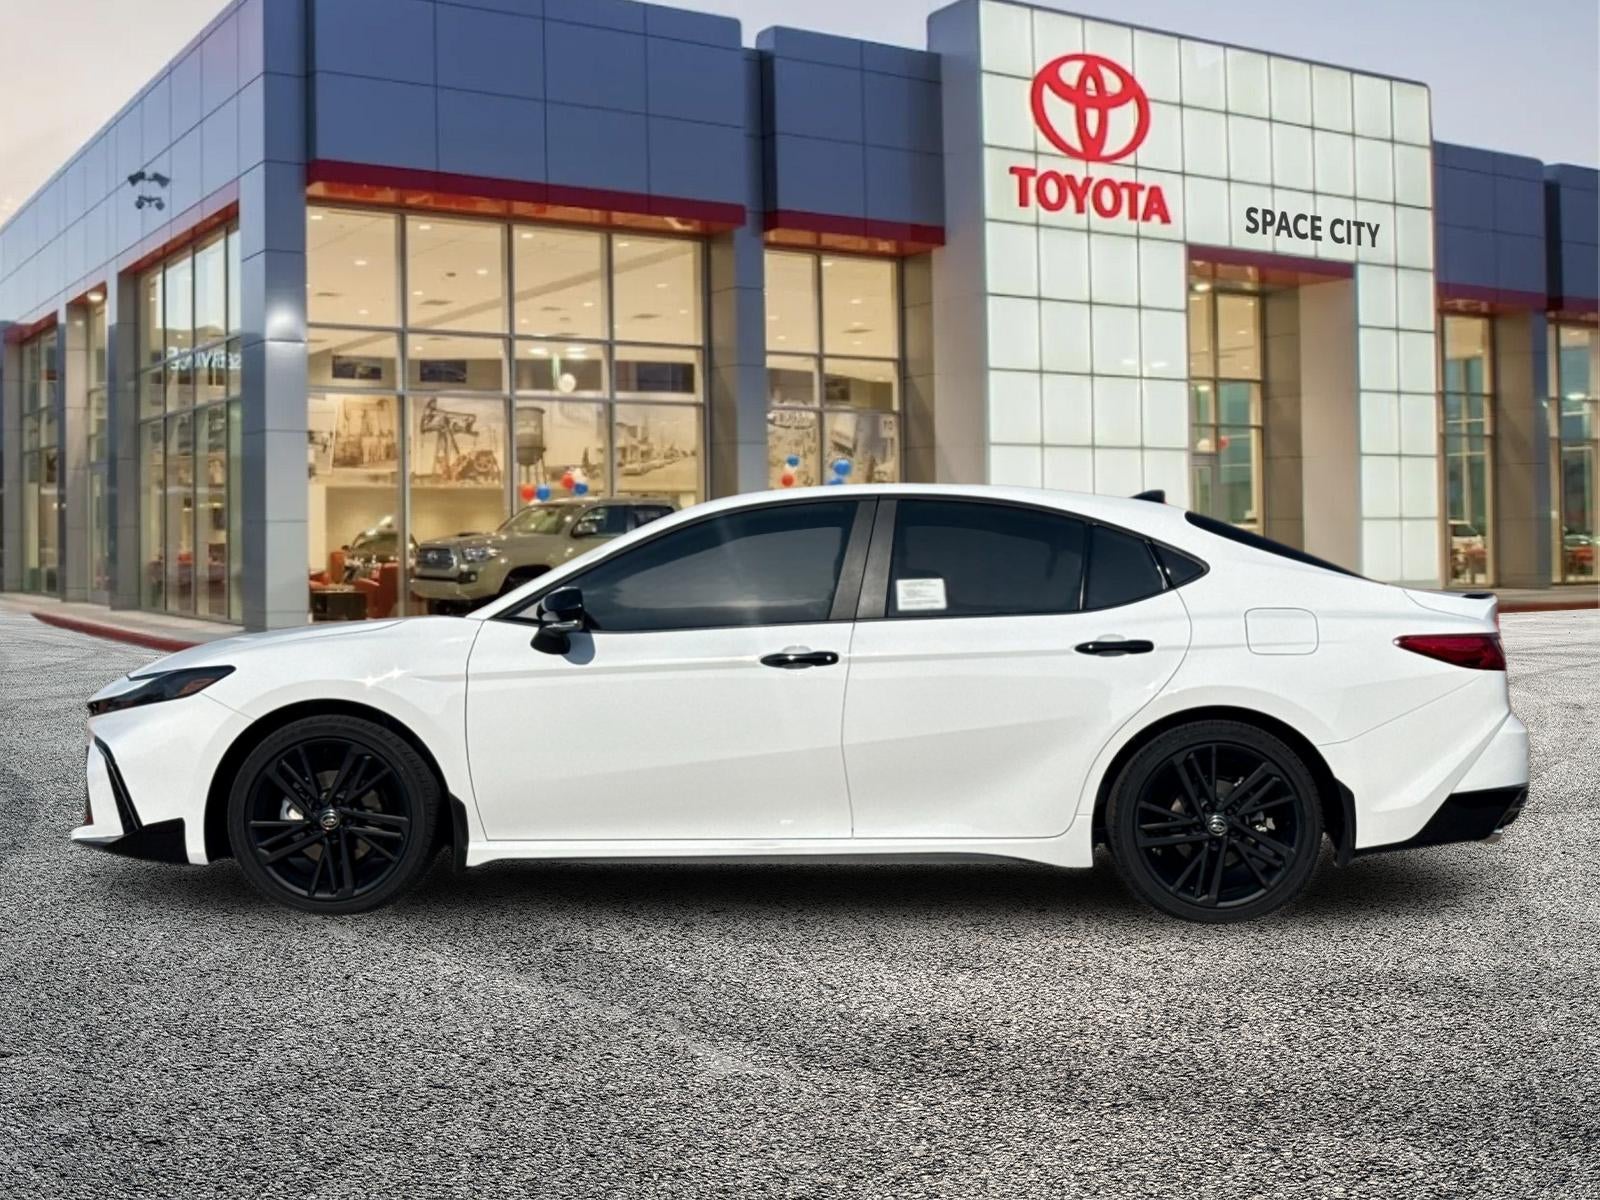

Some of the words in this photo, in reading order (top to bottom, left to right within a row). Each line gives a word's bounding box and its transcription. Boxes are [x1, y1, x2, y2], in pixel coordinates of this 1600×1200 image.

[1009, 166, 1171, 225] TOYOTA
[1245, 206, 1322, 242] SPACE
[1329, 217, 1381, 248] CITY
